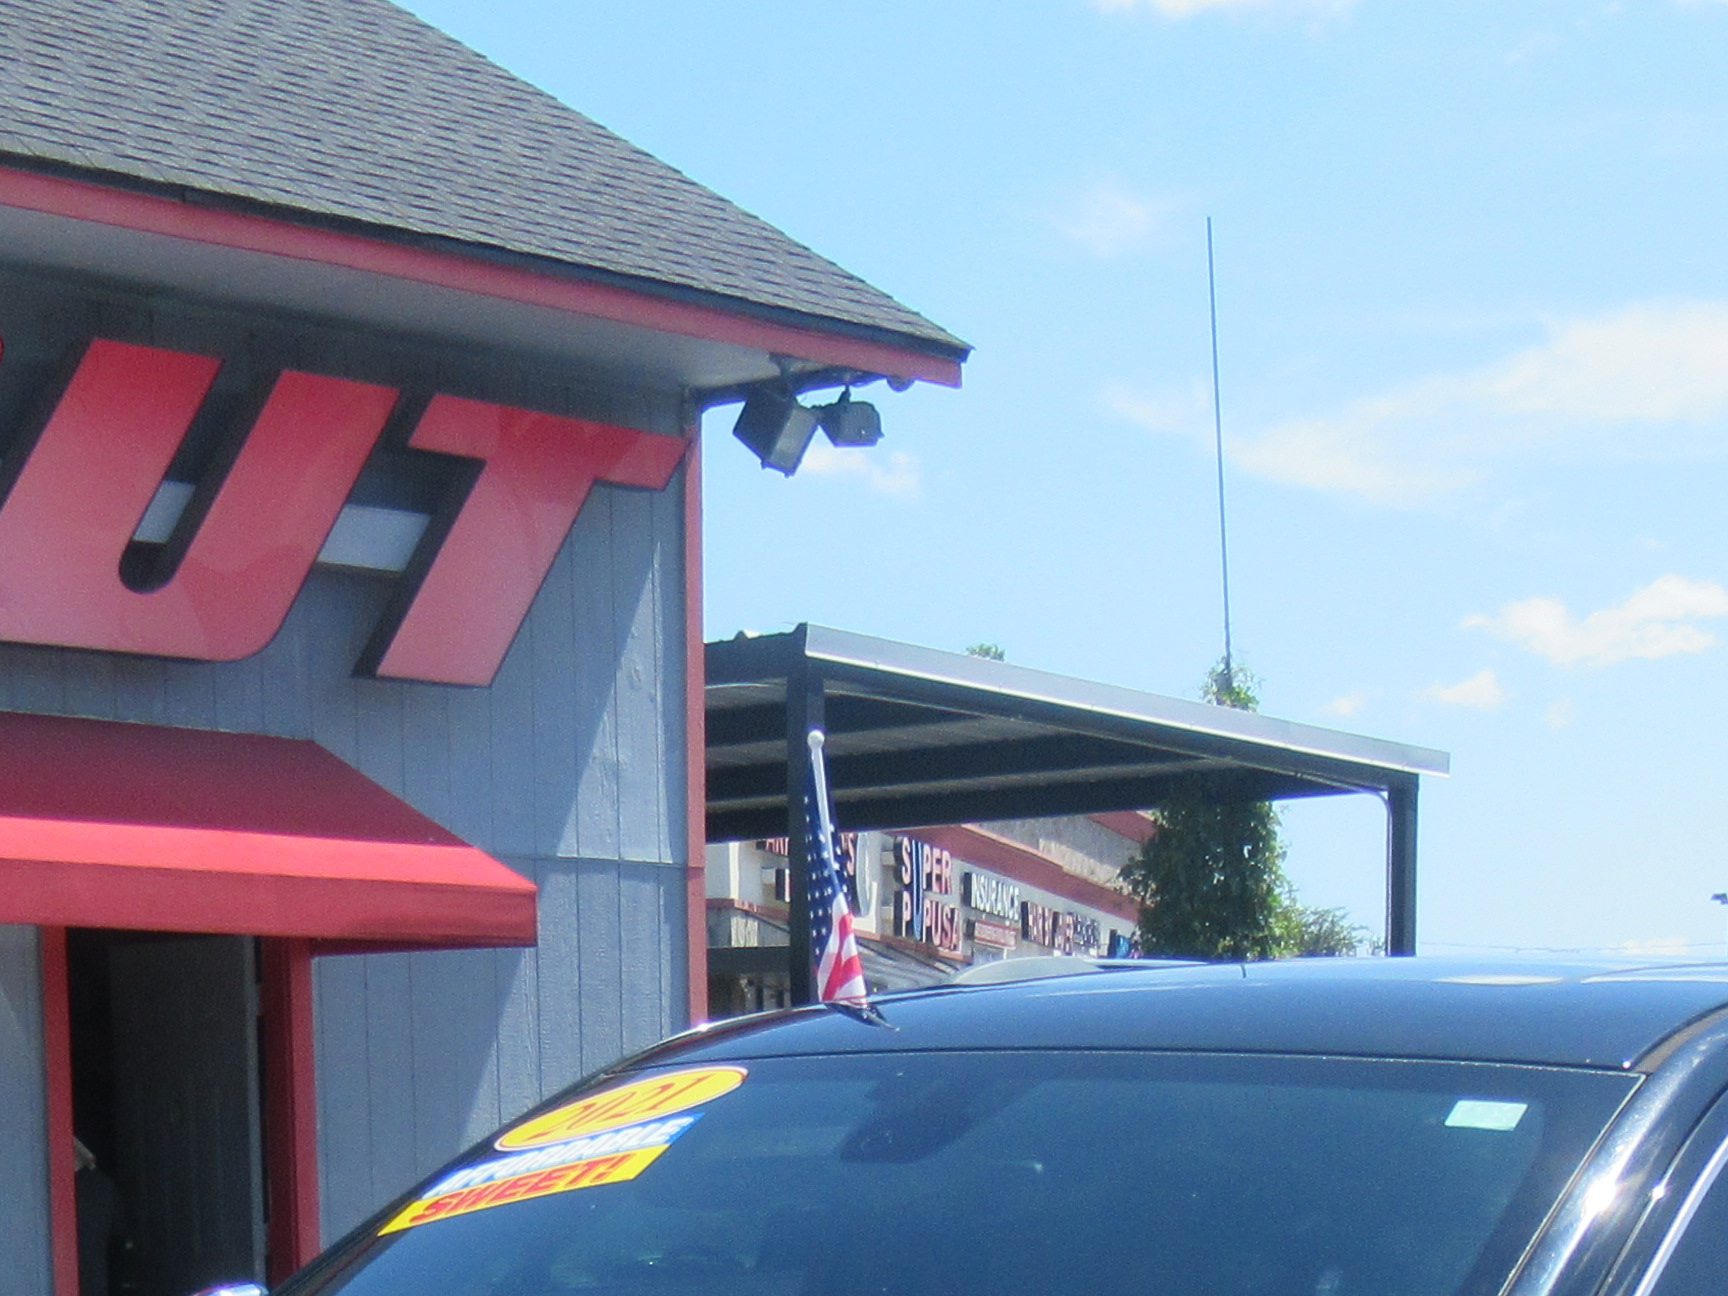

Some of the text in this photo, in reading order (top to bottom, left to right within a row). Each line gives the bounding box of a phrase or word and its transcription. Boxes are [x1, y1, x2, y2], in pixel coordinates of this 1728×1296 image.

[970, 872, 1020, 921] INSURANCE
[524, 1074, 716, 1143] 2021
[408, 1151, 638, 1225] SWEET!
